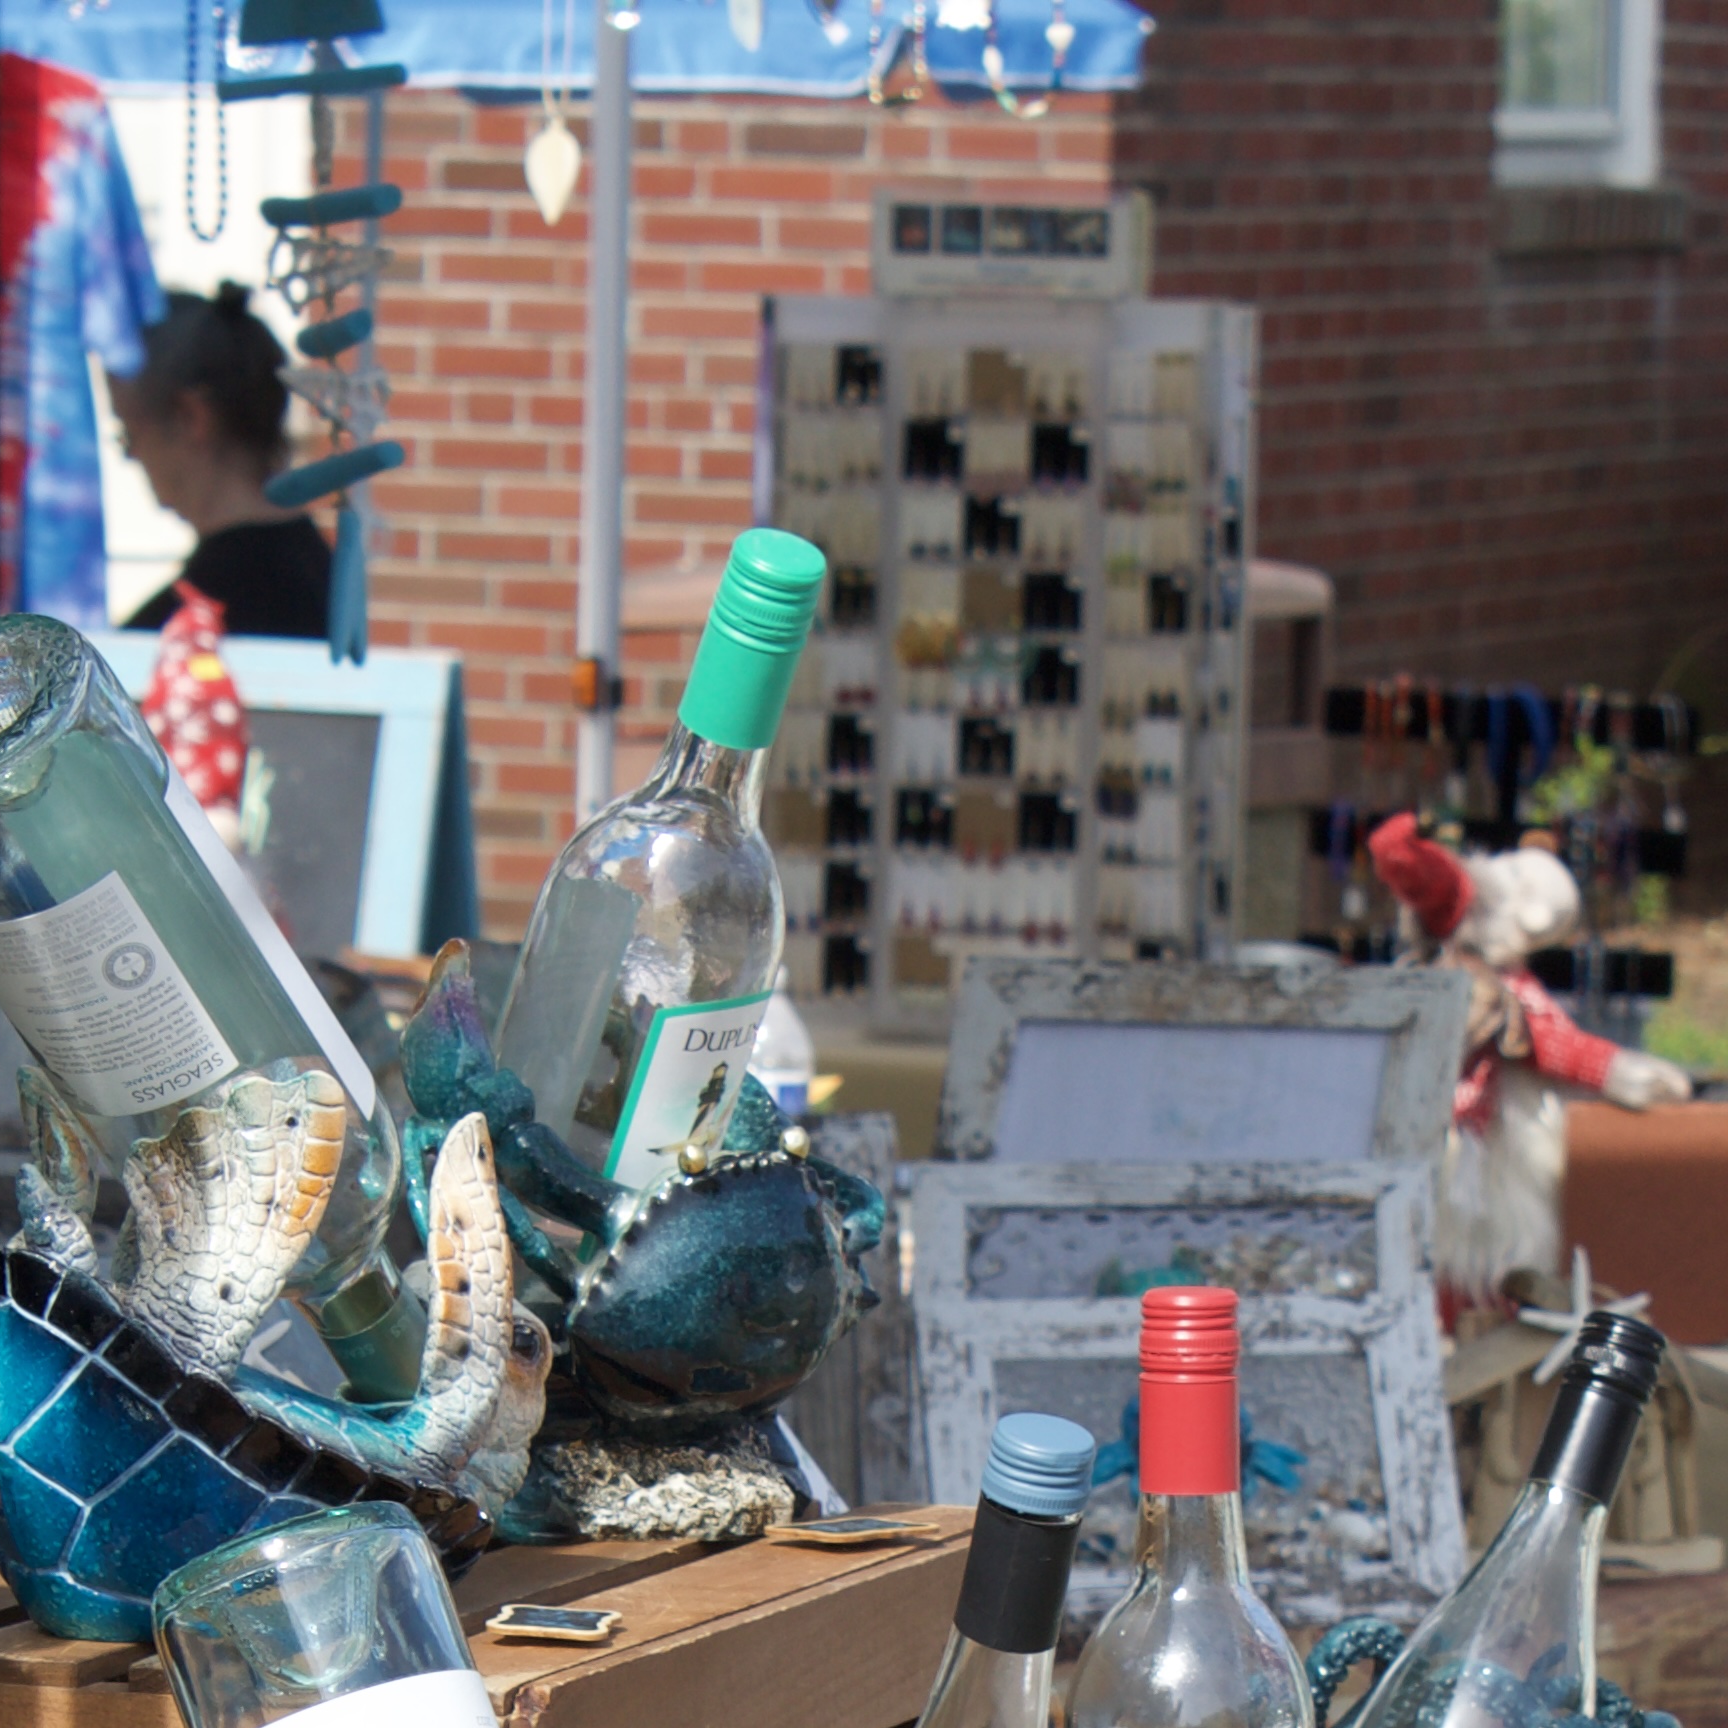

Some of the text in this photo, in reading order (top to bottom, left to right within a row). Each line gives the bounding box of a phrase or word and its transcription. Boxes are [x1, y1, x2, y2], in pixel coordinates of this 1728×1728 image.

[121, 1042, 214, 1088] SAUVIGNON BLANC
[142, 1034, 209, 1073] CENTRAL COAST
[132, 1055, 224, 1104] SEAGLASS
